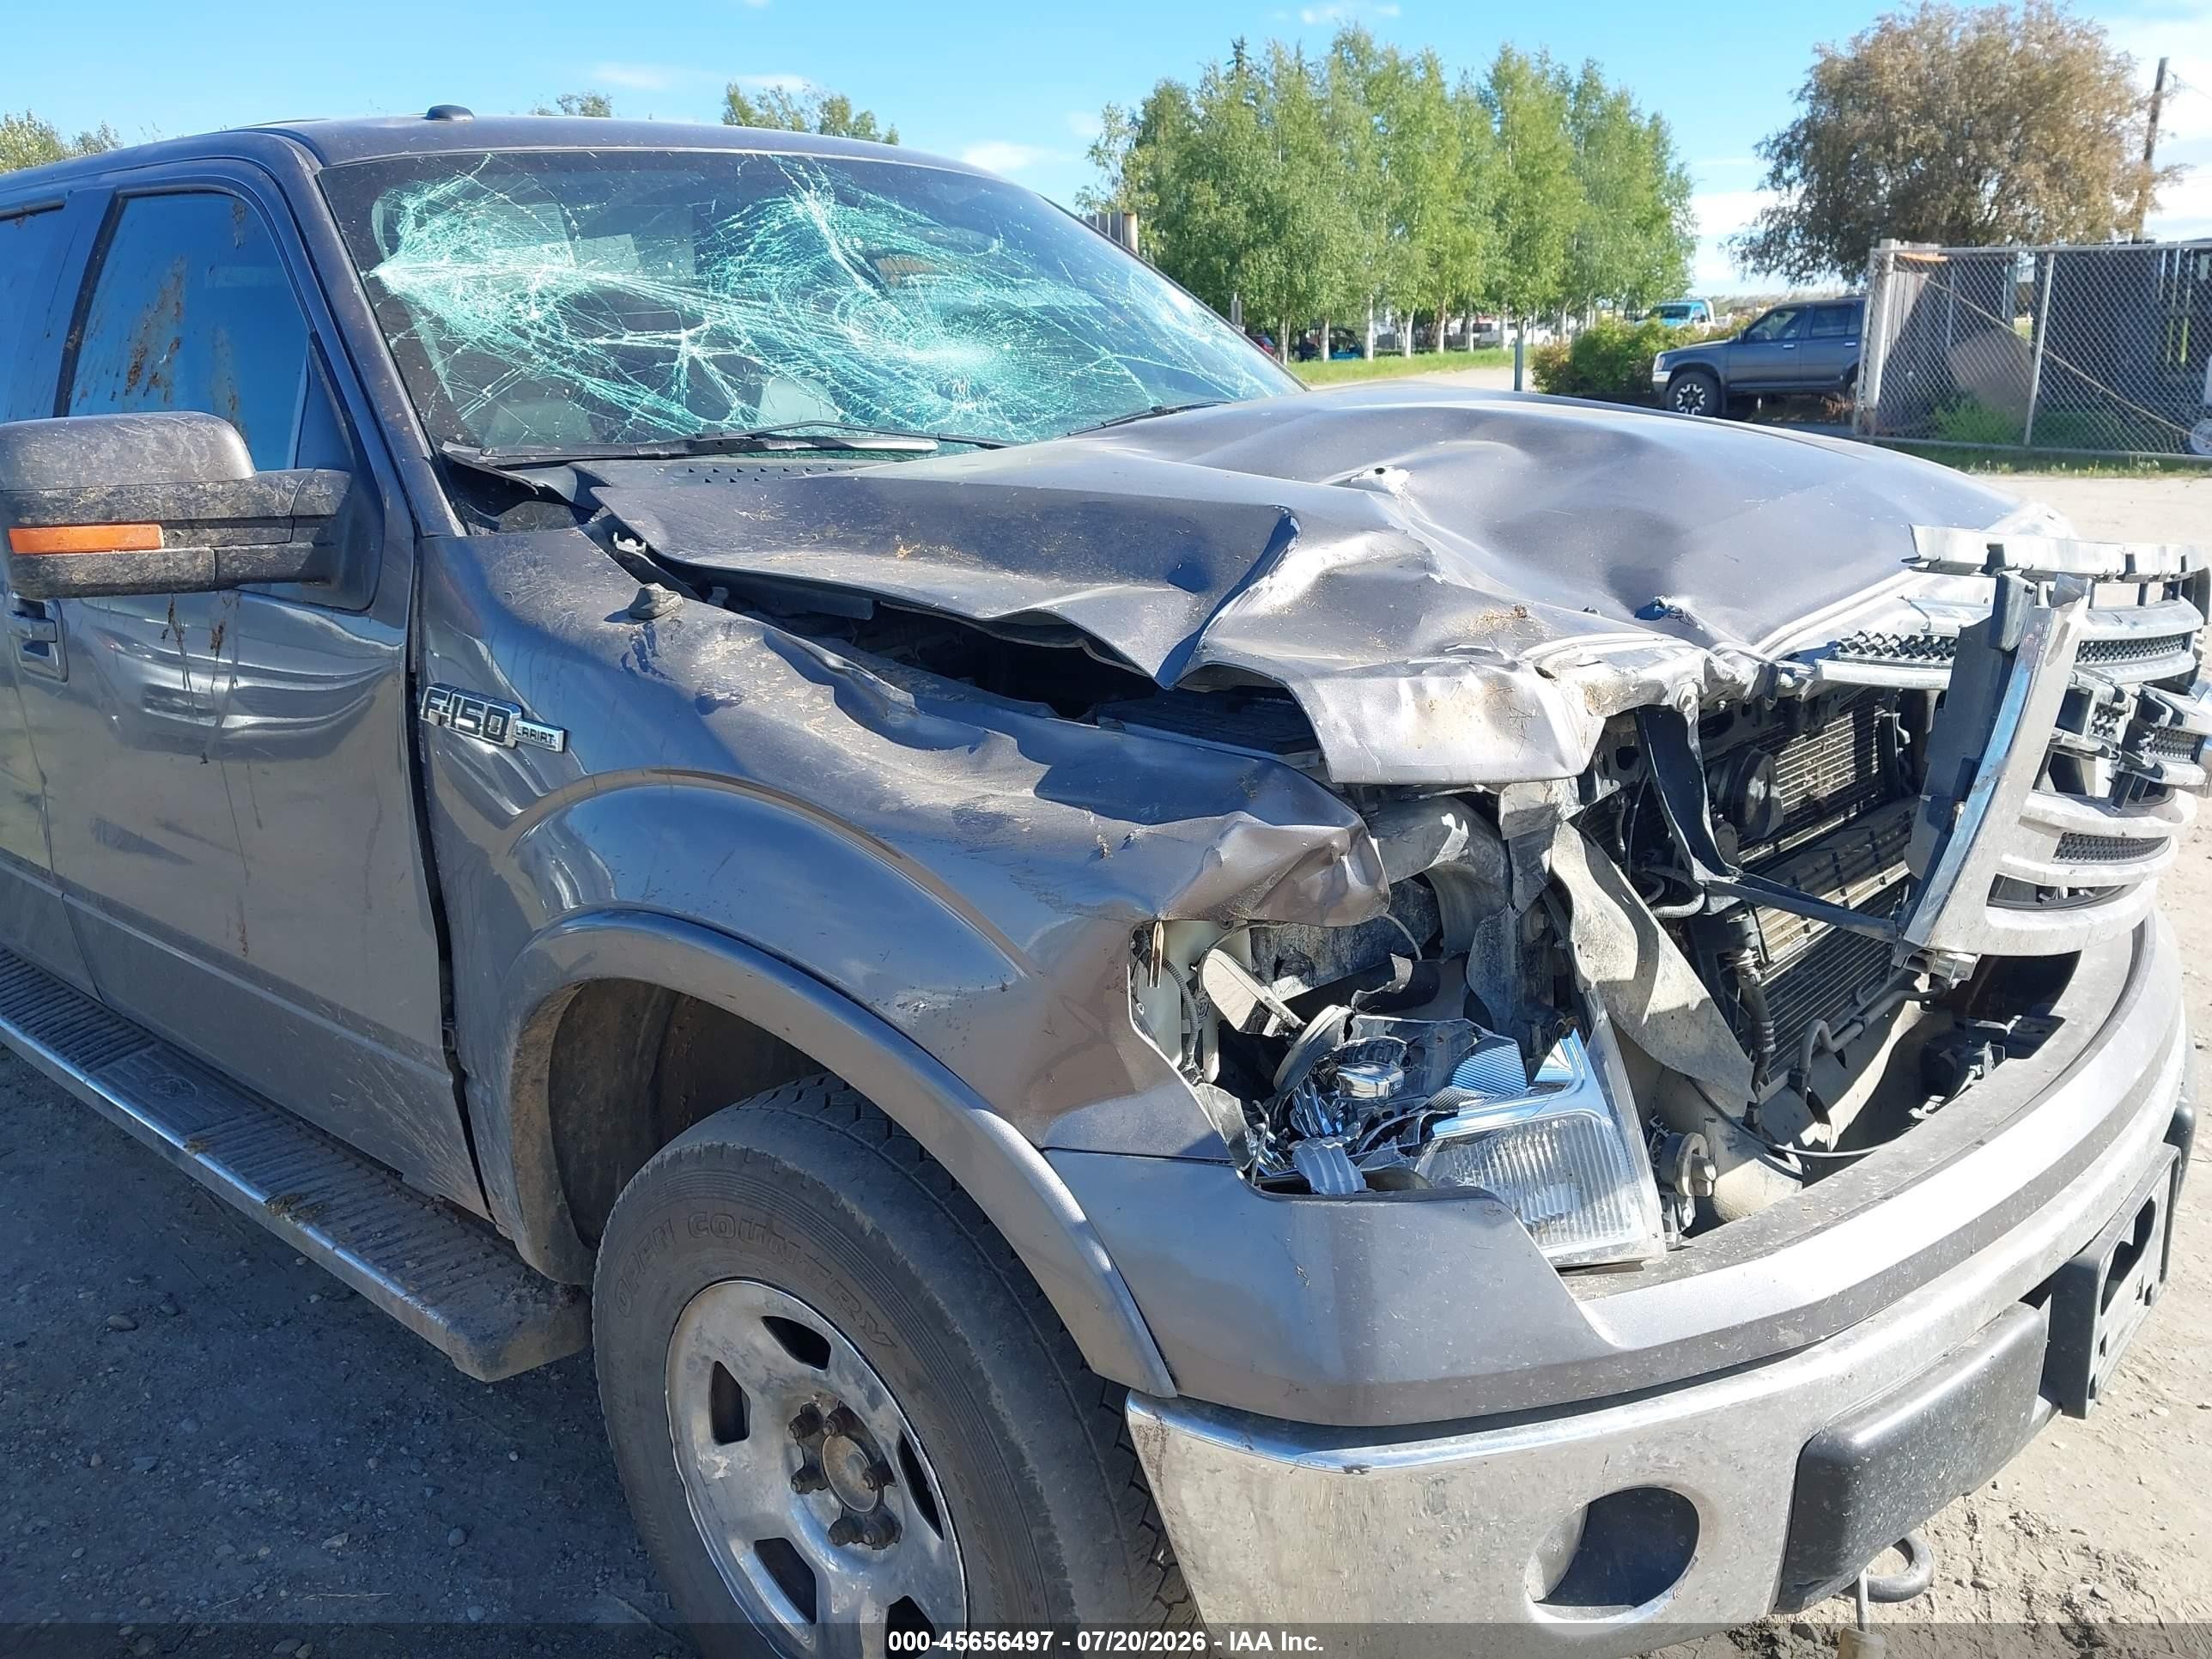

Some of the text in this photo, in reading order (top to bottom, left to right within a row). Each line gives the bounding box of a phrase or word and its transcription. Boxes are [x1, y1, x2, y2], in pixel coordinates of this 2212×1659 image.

[421, 683, 556, 749] F-150 LARIAT
[613, 1211, 897, 1349] OPEN COUNTRY
